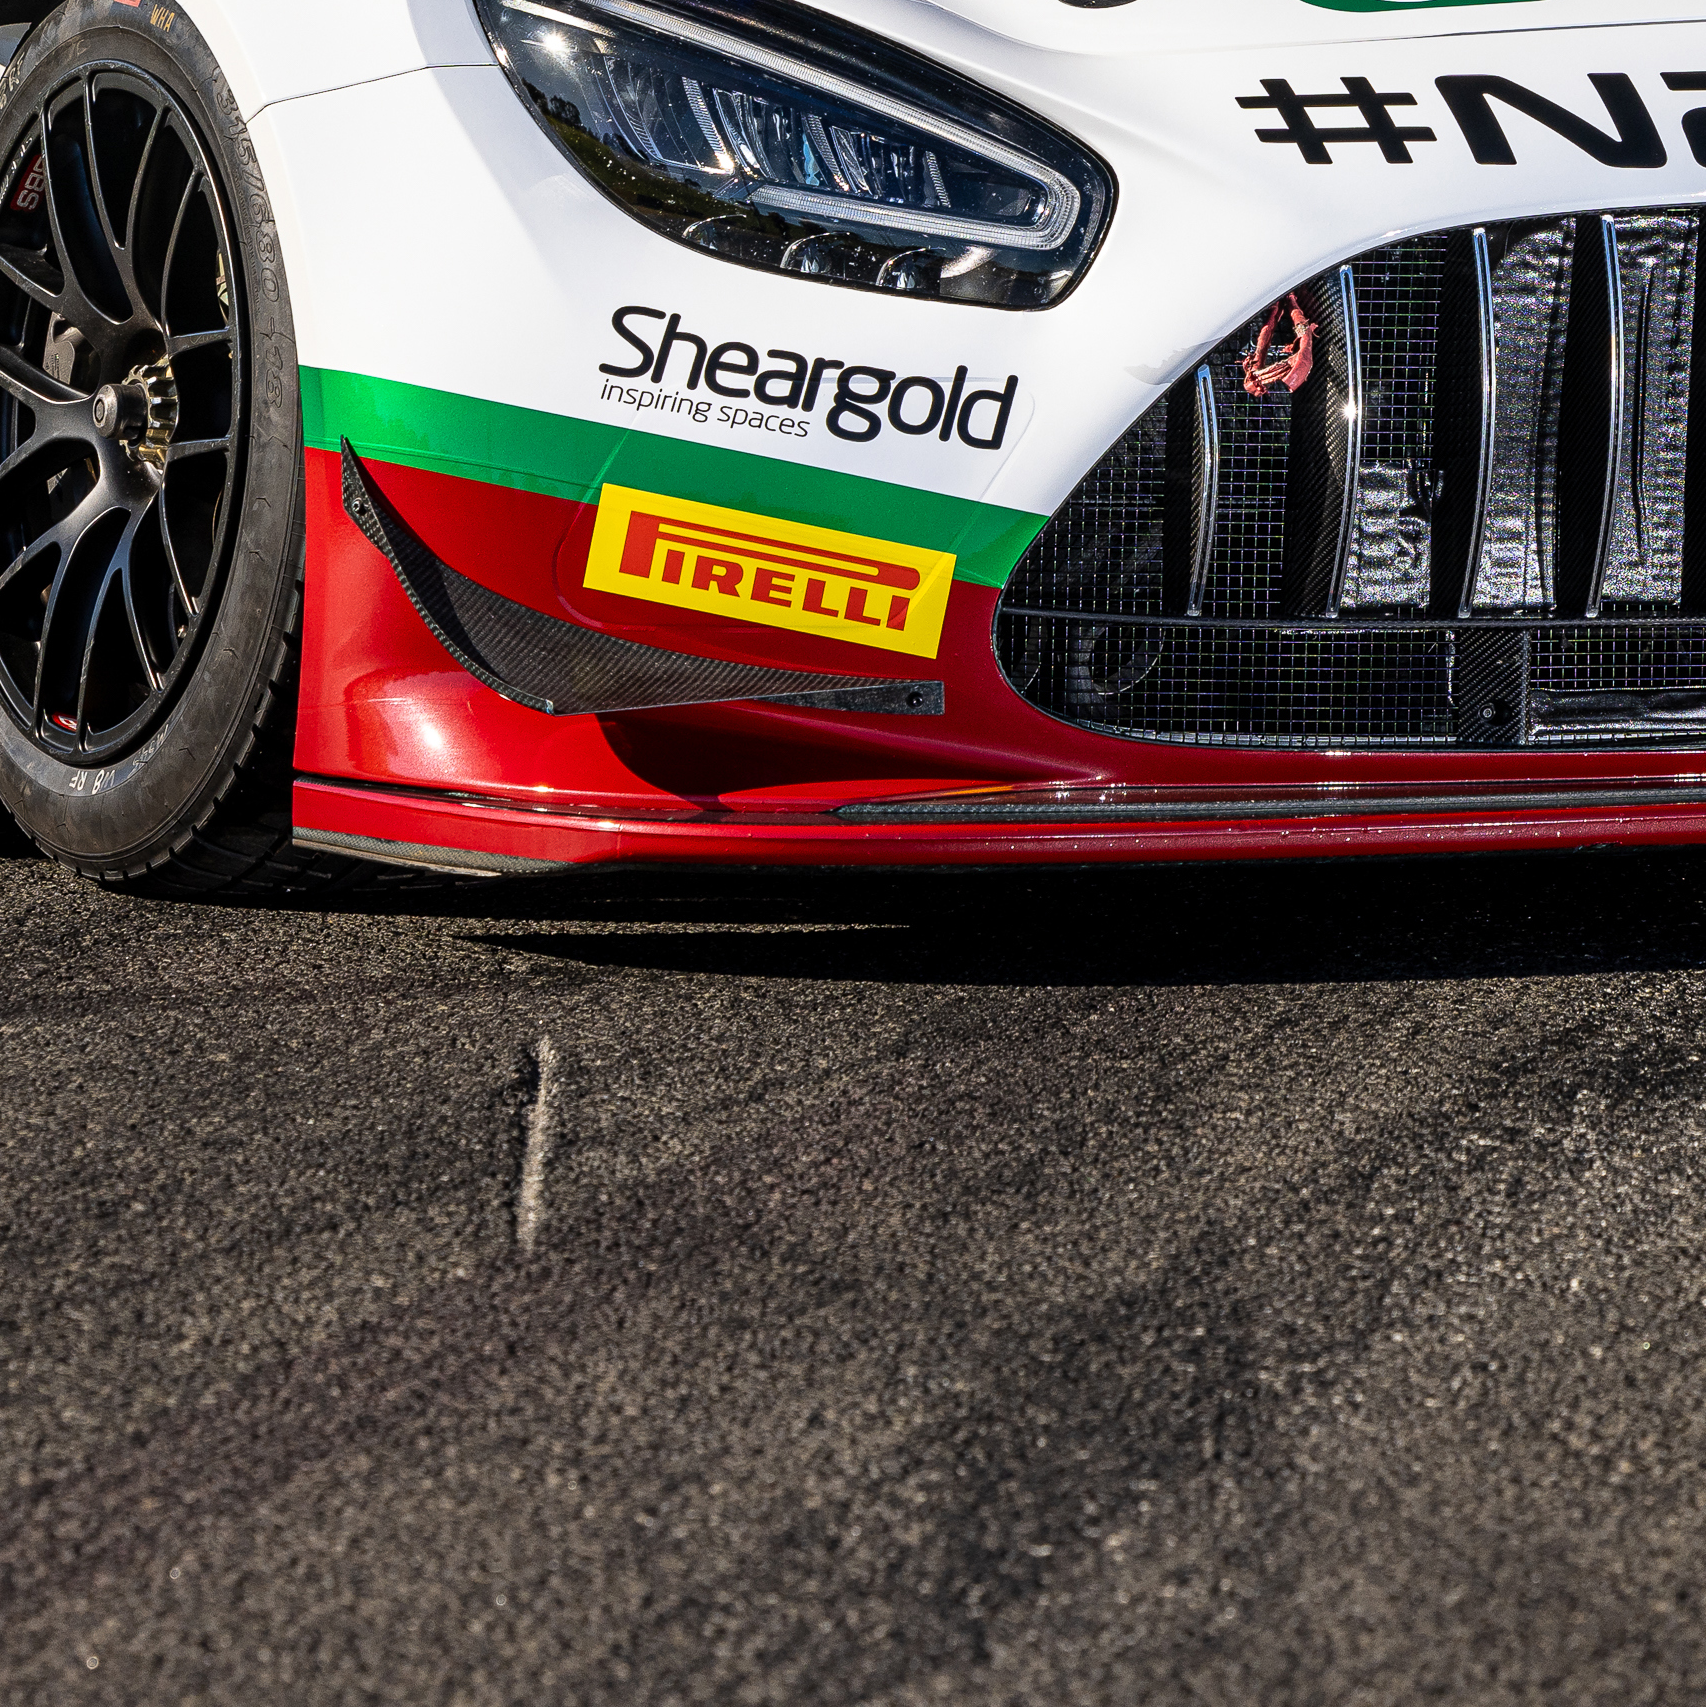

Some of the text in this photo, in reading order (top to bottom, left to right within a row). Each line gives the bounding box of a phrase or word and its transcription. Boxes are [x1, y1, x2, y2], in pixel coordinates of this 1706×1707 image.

[150, 3, 175, 32] WHA
[599, 305, 1020, 451] Sheargold
[600, 378, 811, 439] inspiring spaces
[619, 510, 921, 631] PIRELLI
